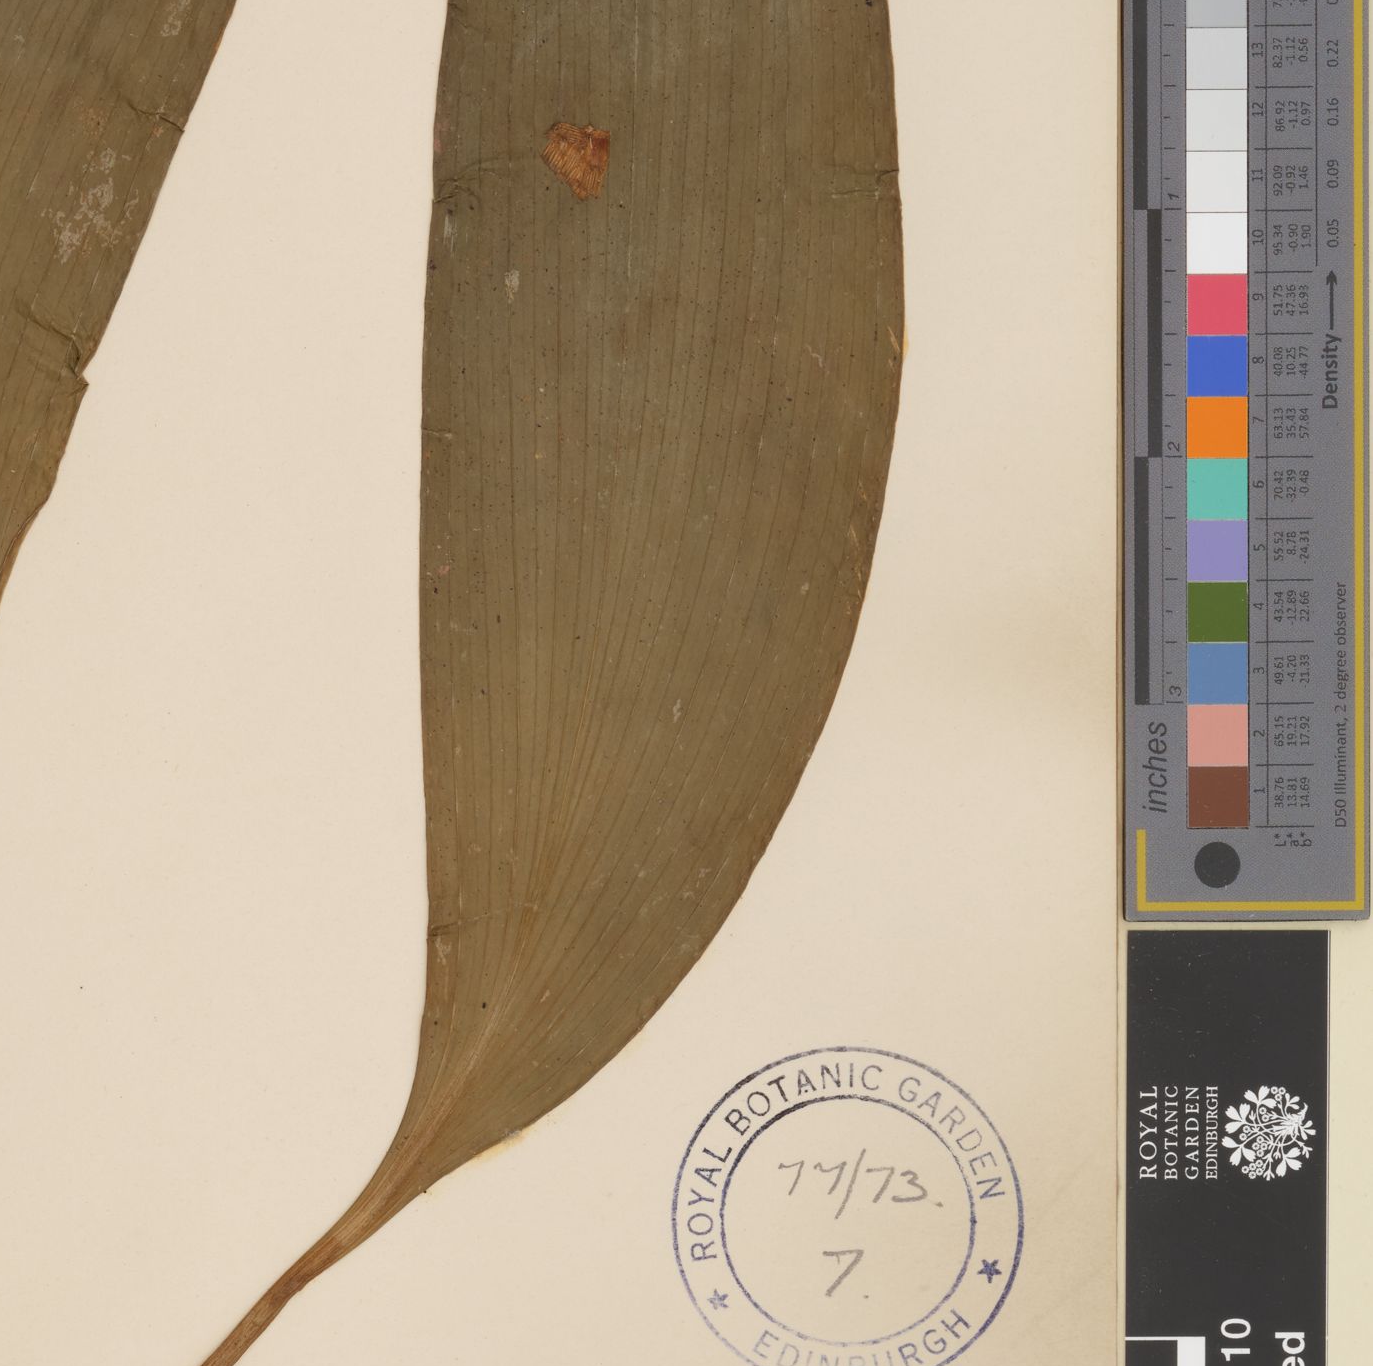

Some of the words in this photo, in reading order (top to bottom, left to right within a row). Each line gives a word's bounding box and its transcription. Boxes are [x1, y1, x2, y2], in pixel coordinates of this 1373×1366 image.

[1251, 43, 1263, 57] 13
[1327, 40, 1338, 67] 0.22
[1252, 103, 1263, 116] 12
[1327, 98, 1338, 126] 0.16
[1252, 169, 1263, 181] 11
[1327, 160, 1339, 188] 0.09
[1252, 229, 1264, 244] 10
[1327, 219, 1339, 247] 0.05
[1252, 356, 1264, 364] 8
[1321, 334, 1341, 408] Density
[1334, 582, 1346, 645] observer
[1334, 651, 1349, 699] degree
[1142, 722, 1167, 813] inches
[1334, 718, 1347, 794] Illuminant,
[1335, 799, 1346, 827] D50
[1139, 1085, 1158, 1180] ROYAL
[1164, 1085, 1179, 1180] BOTANIC
[1184, 1086, 1200, 1180] GARDEN
[1205, 1085, 1219, 1180] EDINBURGH
[687, 1145, 733, 1262] ROYAL
[724, 1063, 883, 1137] BOTANIC
[897, 1077, 1005, 1201] GARDEN
[1220, 1318, 1252, 1362] 10
